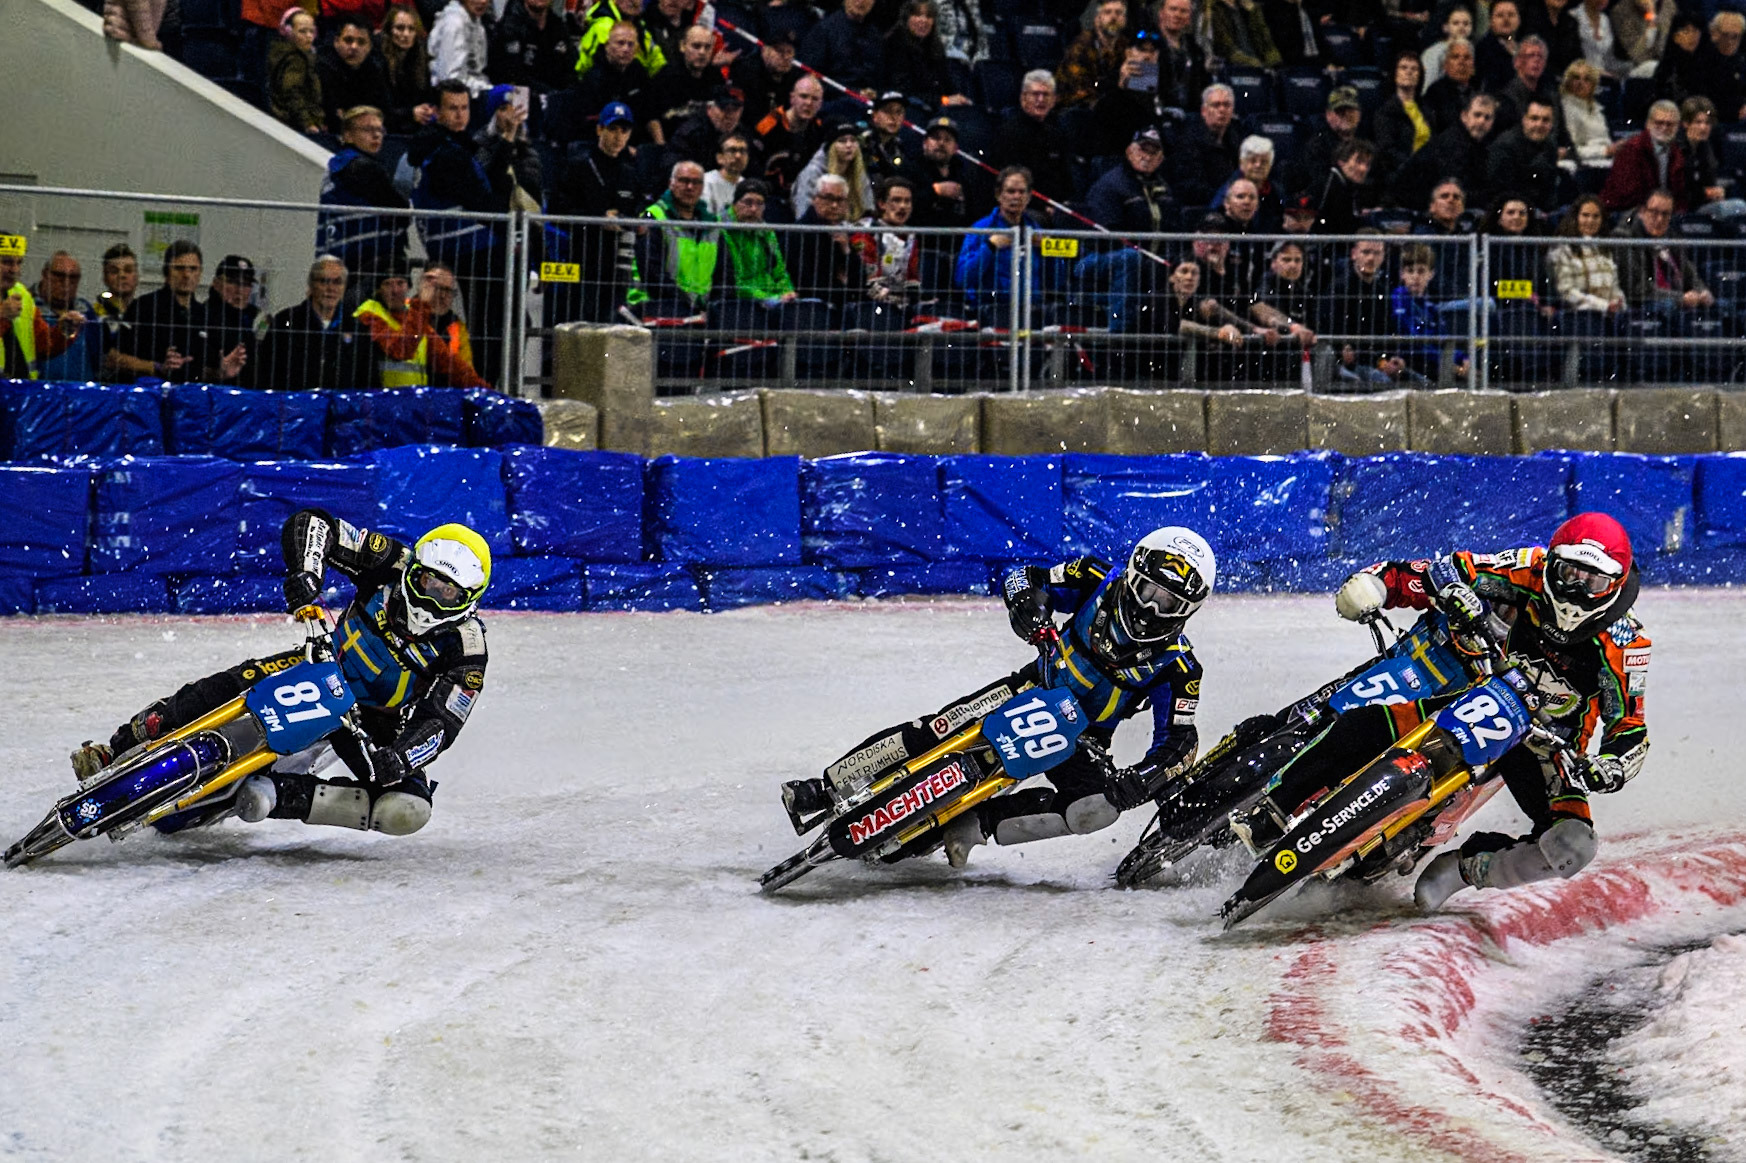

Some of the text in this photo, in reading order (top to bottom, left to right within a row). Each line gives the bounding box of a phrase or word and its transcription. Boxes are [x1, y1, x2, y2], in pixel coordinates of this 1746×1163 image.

[543, 264, 576, 276] D.E.V.
[260, 705, 285, 733] FIM
[274, 681, 331, 724] 81
[1453, 694, 1513, 749] 82
[996, 732, 1021, 760] FIM
[1003, 697, 1069, 759] 199
[1451, 726, 1471, 745] FIM
[837, 737, 896, 776] NORDISKA
[848, 761, 968, 845] MACHTECH
